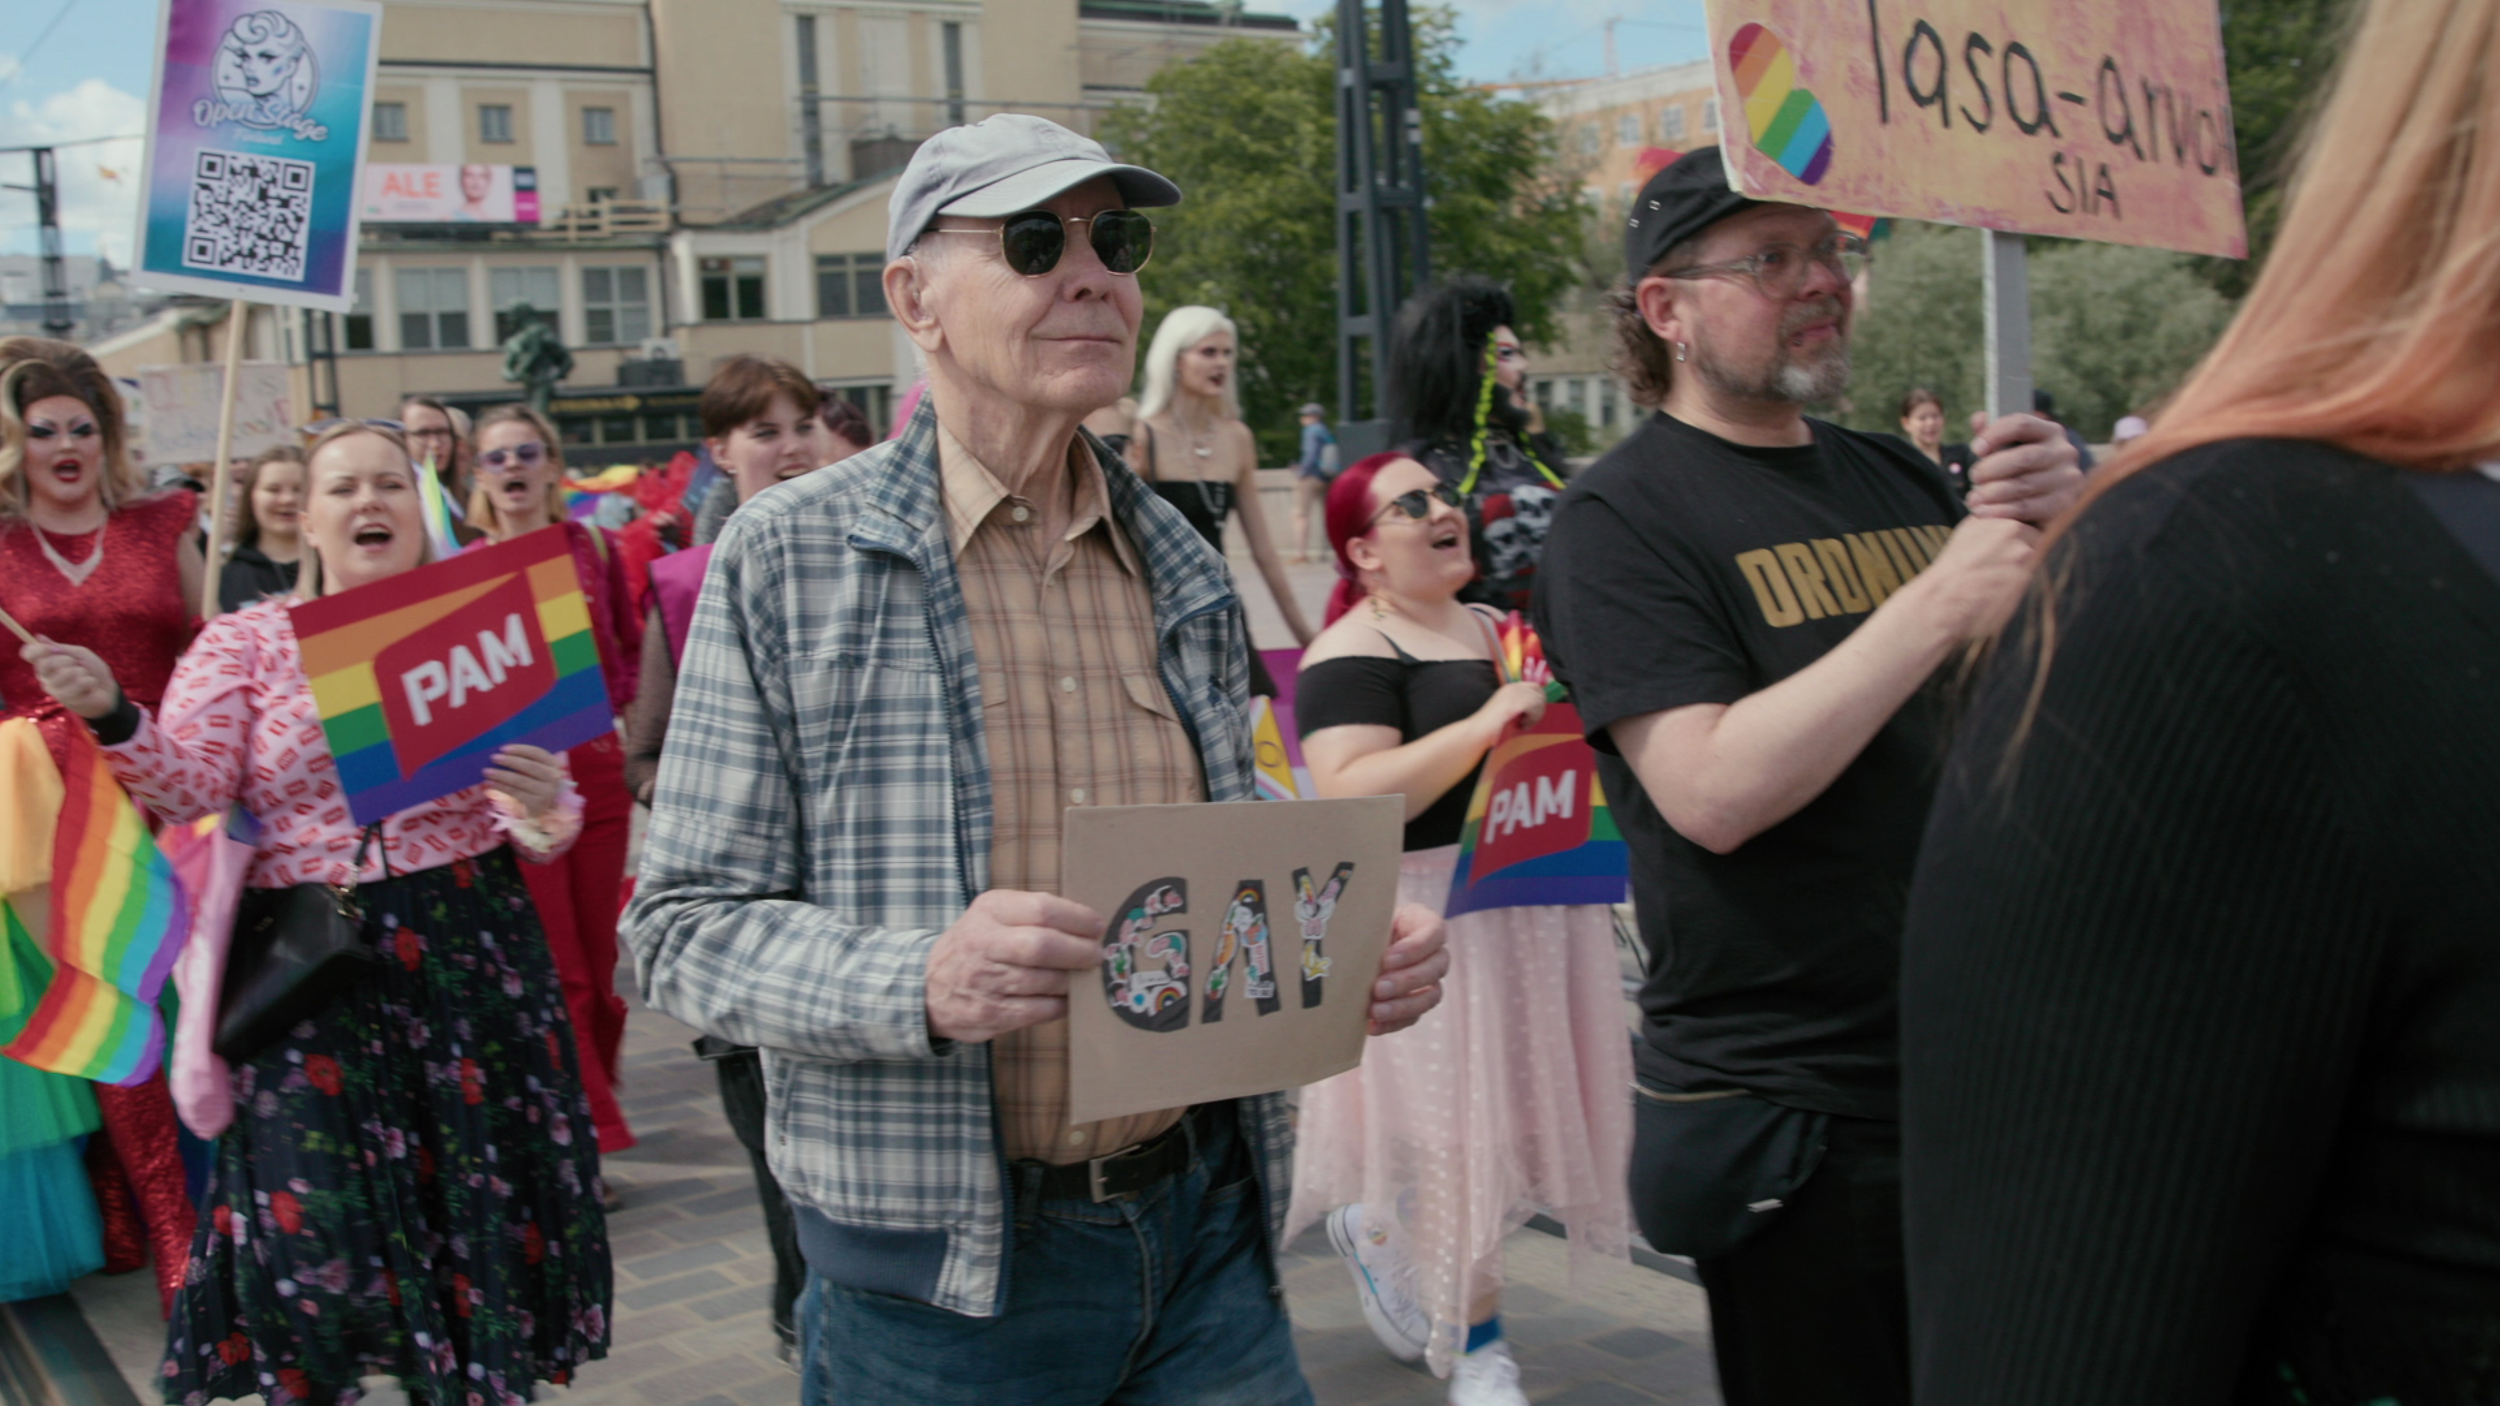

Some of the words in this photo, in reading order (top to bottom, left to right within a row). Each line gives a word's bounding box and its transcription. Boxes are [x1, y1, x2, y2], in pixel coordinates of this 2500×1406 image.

[193, 98, 257, 128] Open
[262, 99, 329, 141] Stage
[381, 172, 443, 198] ALE
[2047, 151, 2122, 220] SIA
[401, 613, 535, 726] PAM
[1484, 769, 1577, 845] PAM
[1102, 862, 1355, 1033] GAY
